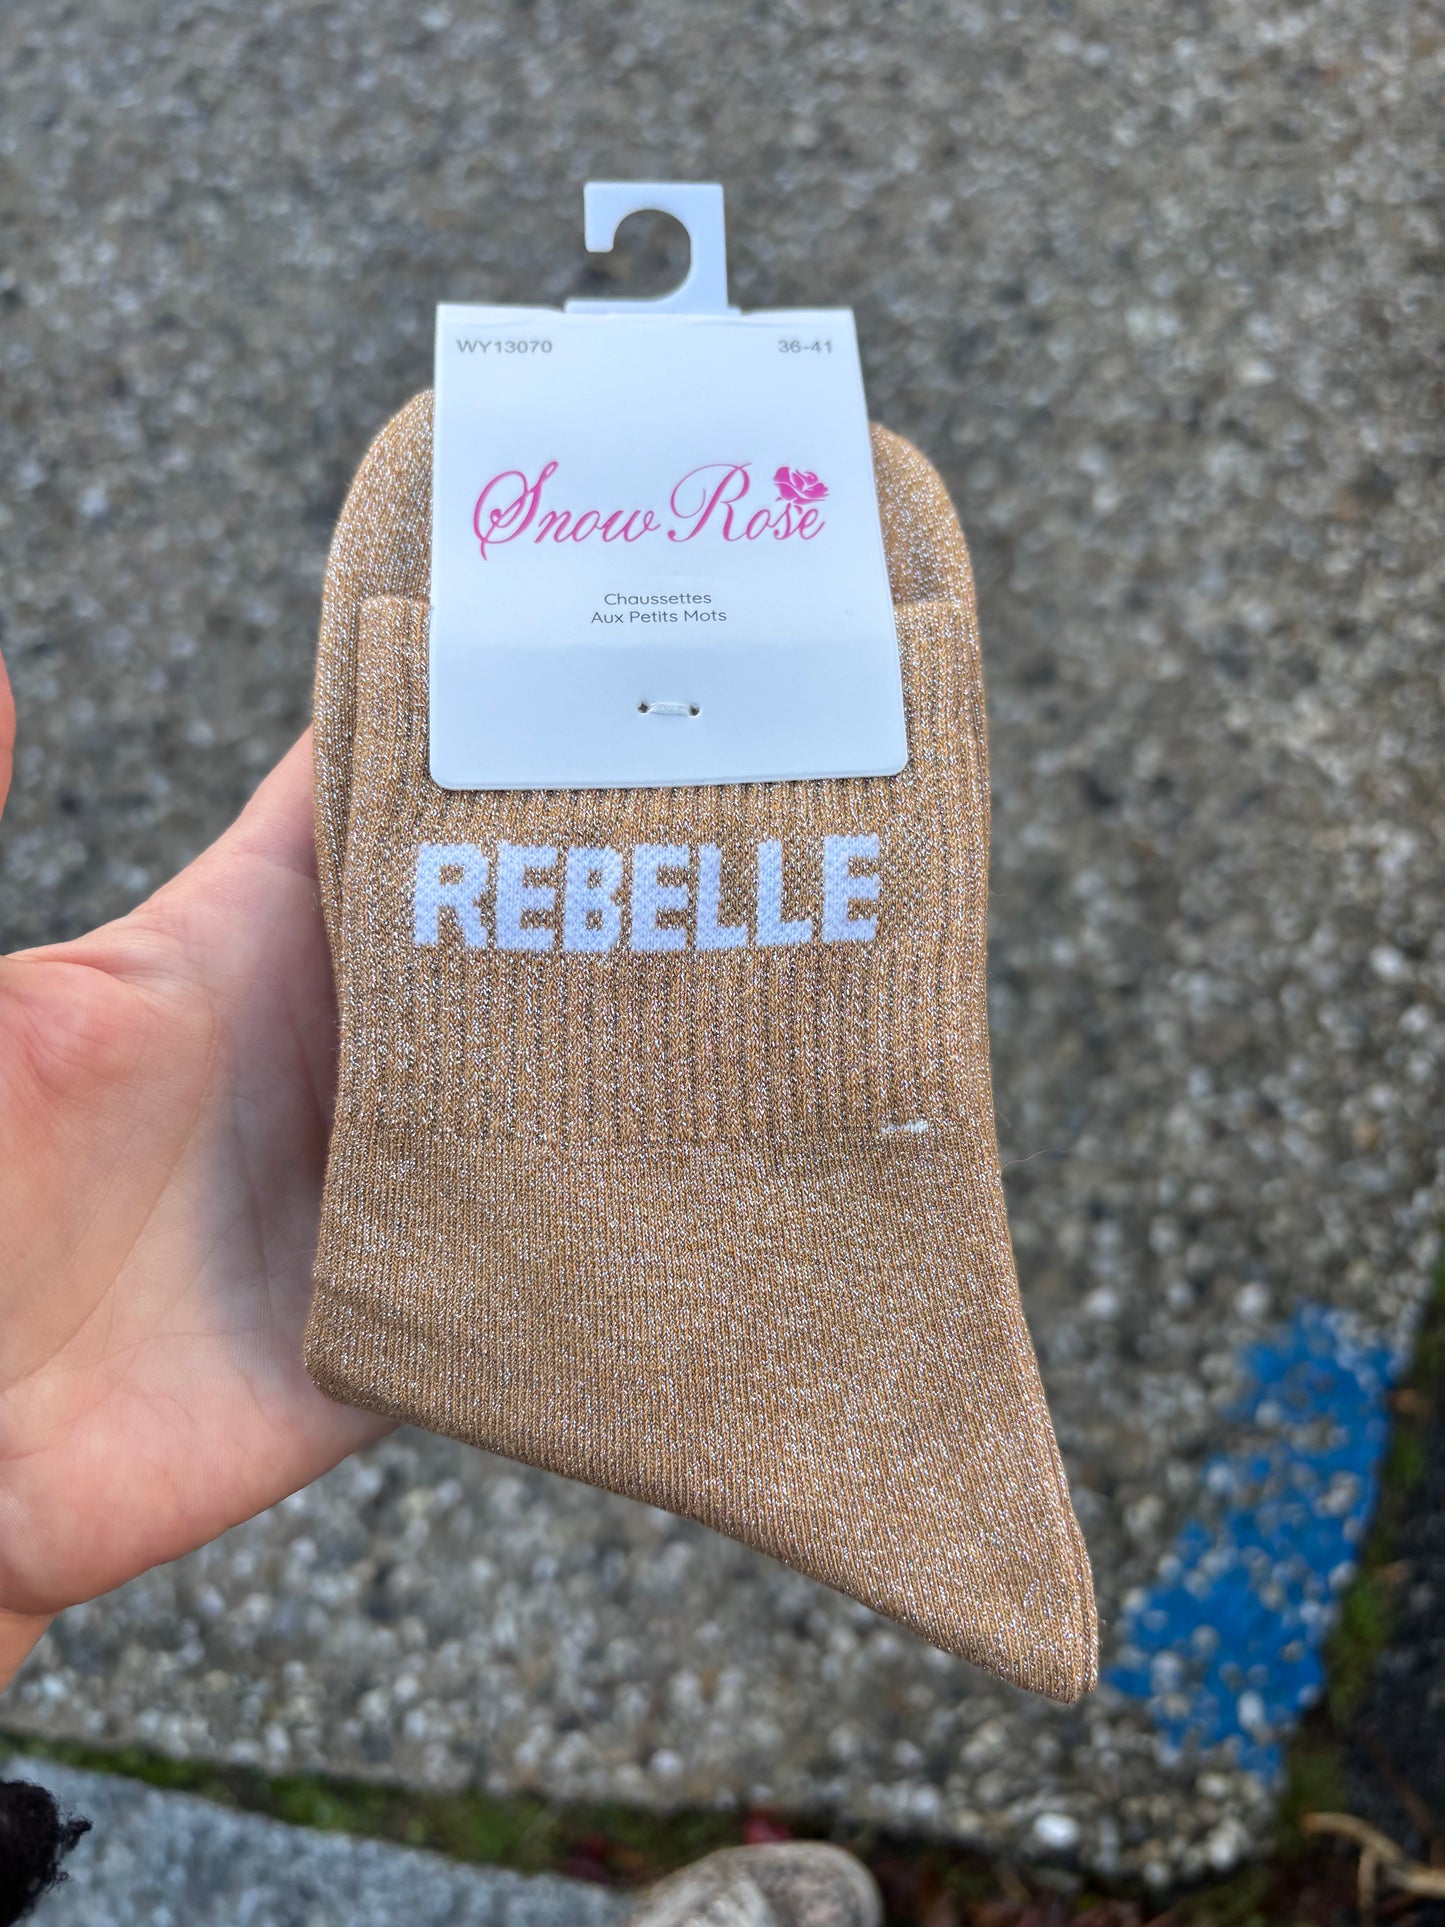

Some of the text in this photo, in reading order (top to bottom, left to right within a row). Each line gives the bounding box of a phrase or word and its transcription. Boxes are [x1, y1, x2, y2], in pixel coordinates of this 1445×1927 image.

[455, 339, 553, 355] WY13070
[777, 339, 833, 355] 36-41
[473, 460, 826, 561] Snow Rose
[603, 591, 712, 606] Chaussettes
[590, 608, 728, 624] Aux Petits Mots
[413, 833, 881, 954] REBELLE
